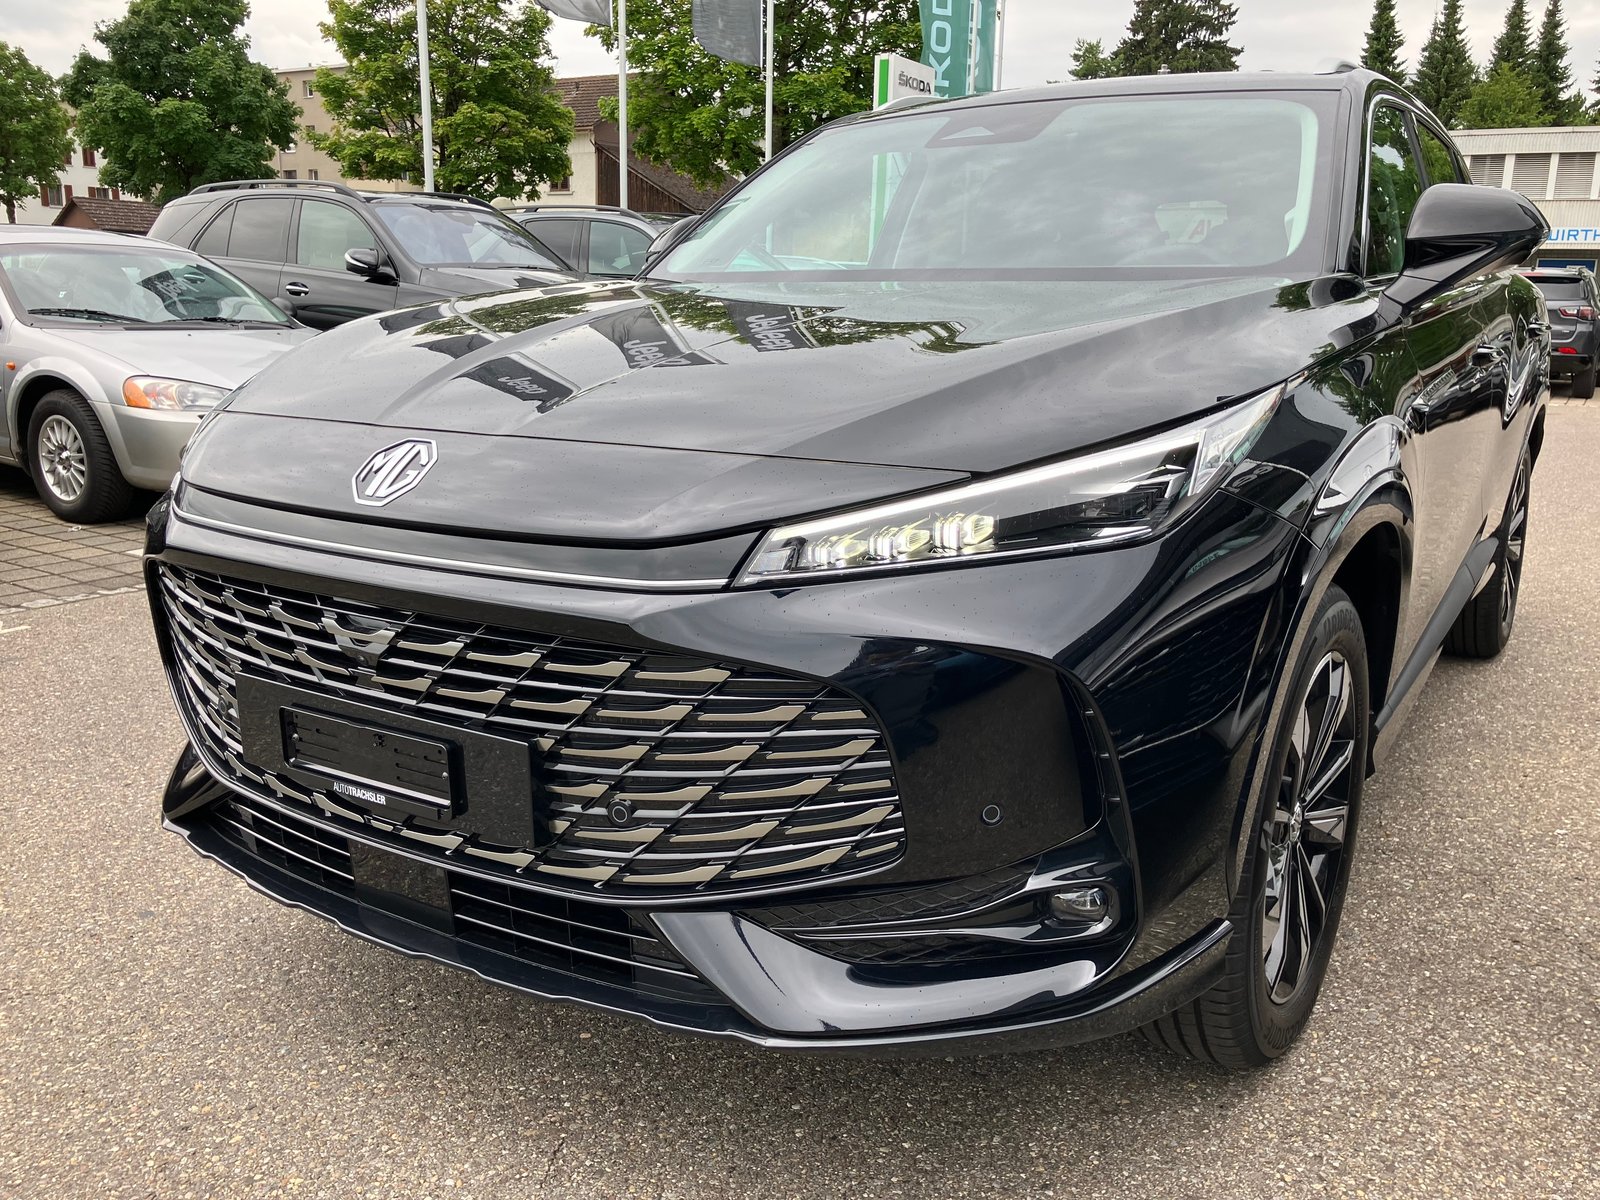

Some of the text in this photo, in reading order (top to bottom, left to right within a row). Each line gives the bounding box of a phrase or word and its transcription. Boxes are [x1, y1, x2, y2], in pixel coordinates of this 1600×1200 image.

[898, 70, 932, 95] ŠKODA
[497, 376, 548, 395] Jeep
[359, 442, 429, 498] MG
[333, 781, 386, 805] AUTOTRACHSLER
